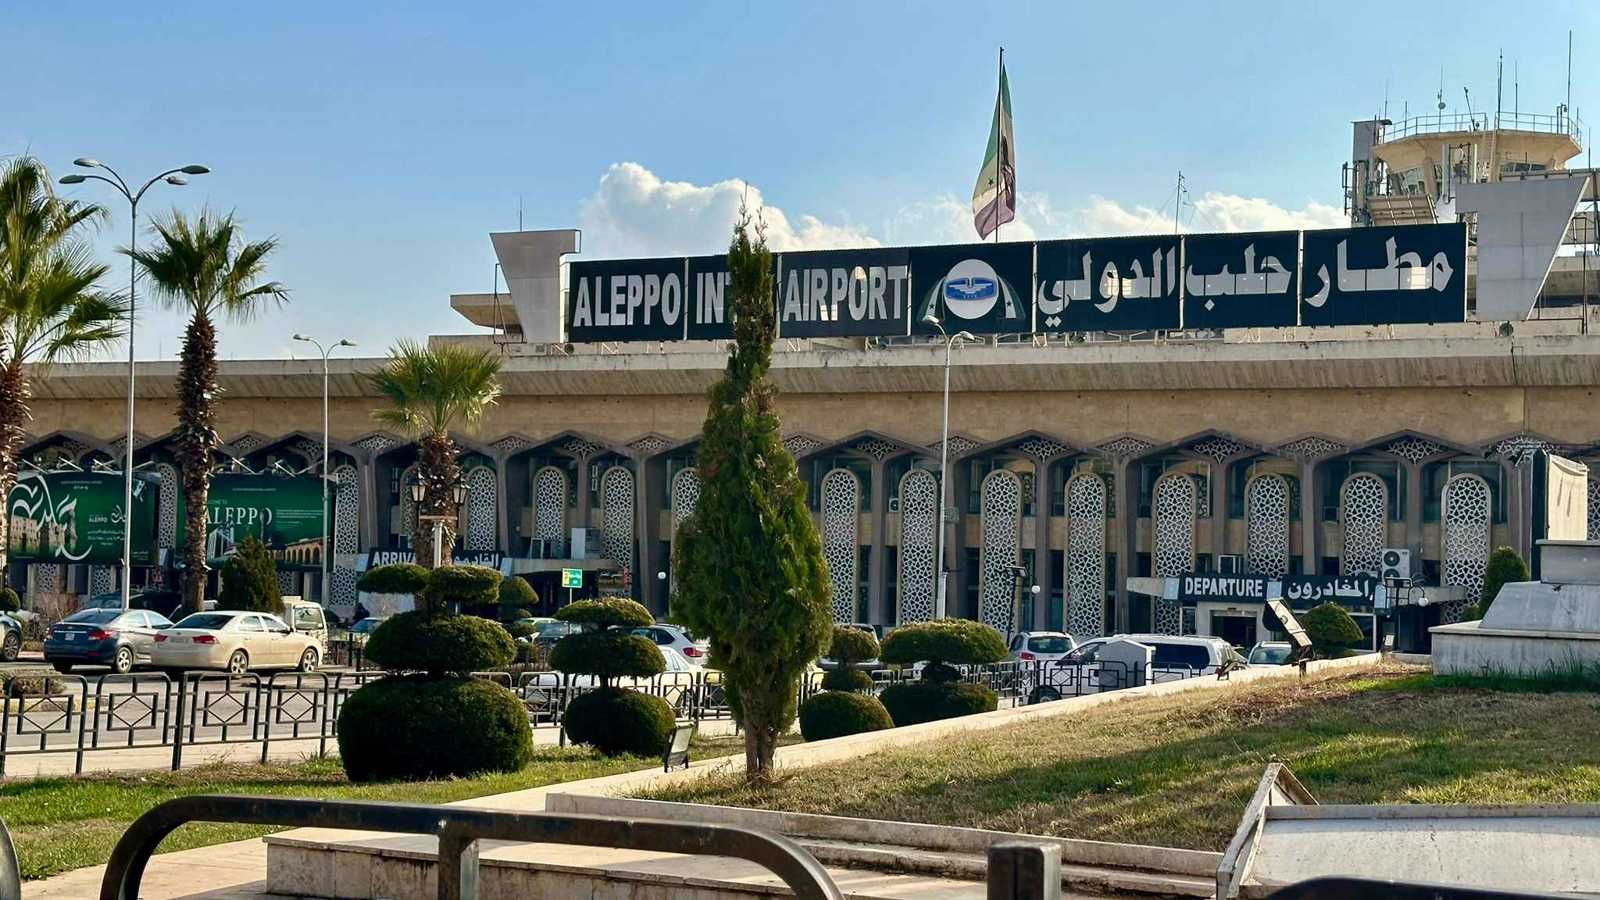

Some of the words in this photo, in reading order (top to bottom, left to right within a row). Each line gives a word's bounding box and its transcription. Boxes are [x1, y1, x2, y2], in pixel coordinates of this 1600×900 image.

[573, 273, 681, 327] ALEPPO
[696, 272, 732, 324] IN
[782, 265, 908, 321] AIRPORT
[1038, 246, 1176, 327] الدولي
[1186, 243, 1292, 311] حلب
[1304, 236, 1453, 307] مطار
[1184, 577, 1264, 597] DEPARTURE
[1287, 578, 1370, 600] المغادرون
